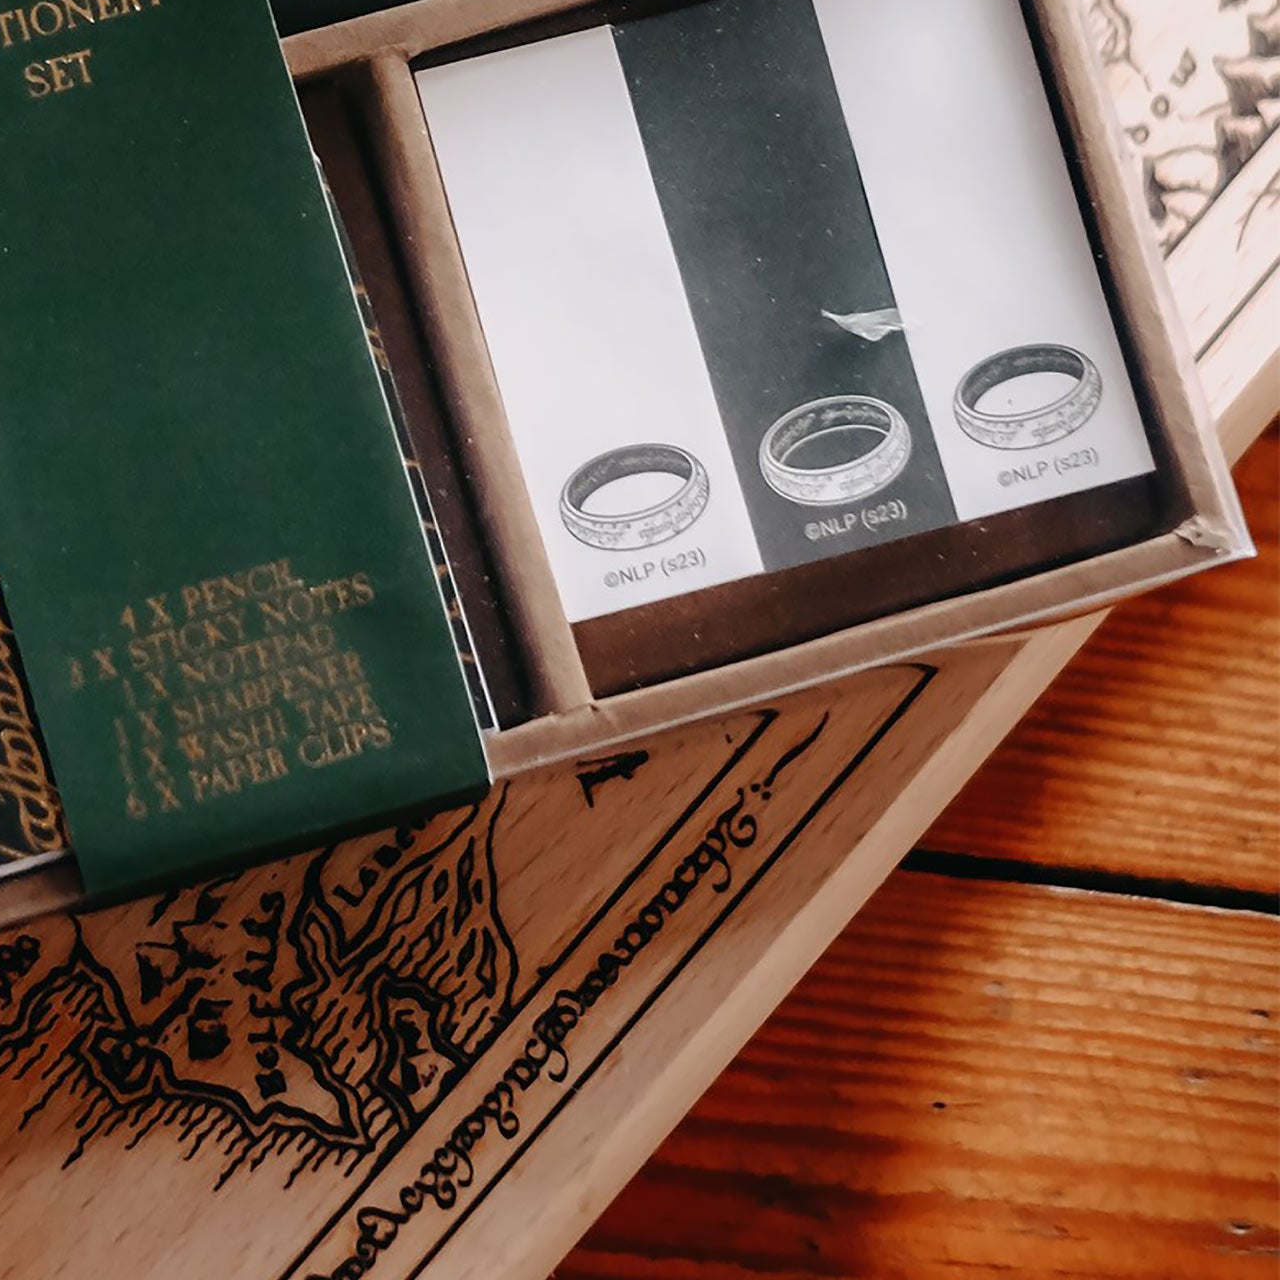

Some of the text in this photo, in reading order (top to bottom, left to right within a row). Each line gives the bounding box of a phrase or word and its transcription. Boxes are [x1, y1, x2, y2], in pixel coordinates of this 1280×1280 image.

[24, 49, 94, 99] SET
[257, 572, 375, 632] NOTES
[188, 748, 290, 803] PAPER
[298, 721, 393, 769] CLIPS
